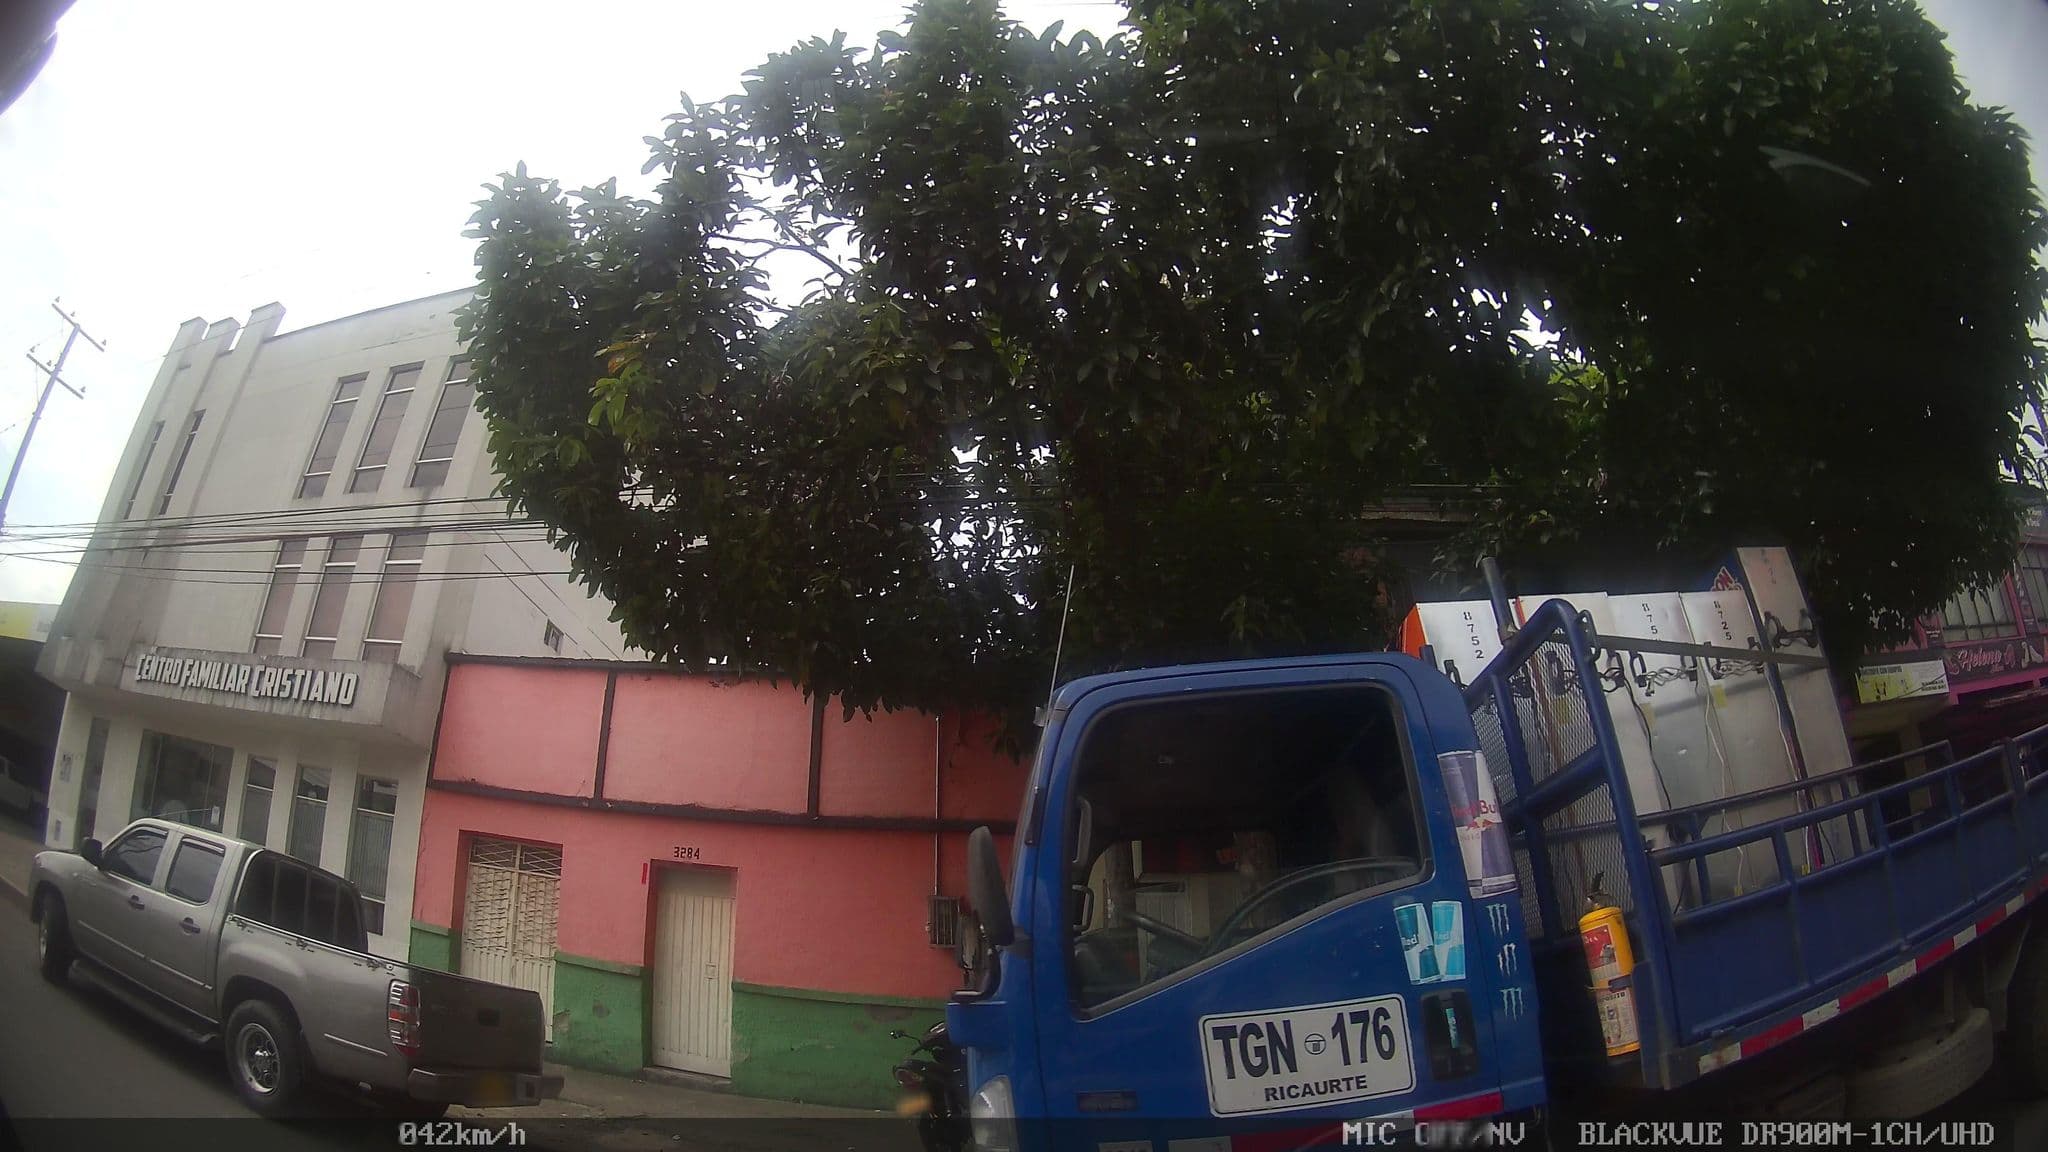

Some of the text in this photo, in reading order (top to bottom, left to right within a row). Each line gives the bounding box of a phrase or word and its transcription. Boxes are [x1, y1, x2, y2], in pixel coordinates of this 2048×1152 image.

[1641, 602, 1663, 641] 875
[135, 653, 360, 706] CENTRO FAMILIAR CRISTIANO
[673, 846, 700, 860] 3284
[1212, 1019, 1299, 1080] TGN
[1331, 1006, 1396, 1067] 176
[1264, 1074, 1368, 1102] RICAURTE
